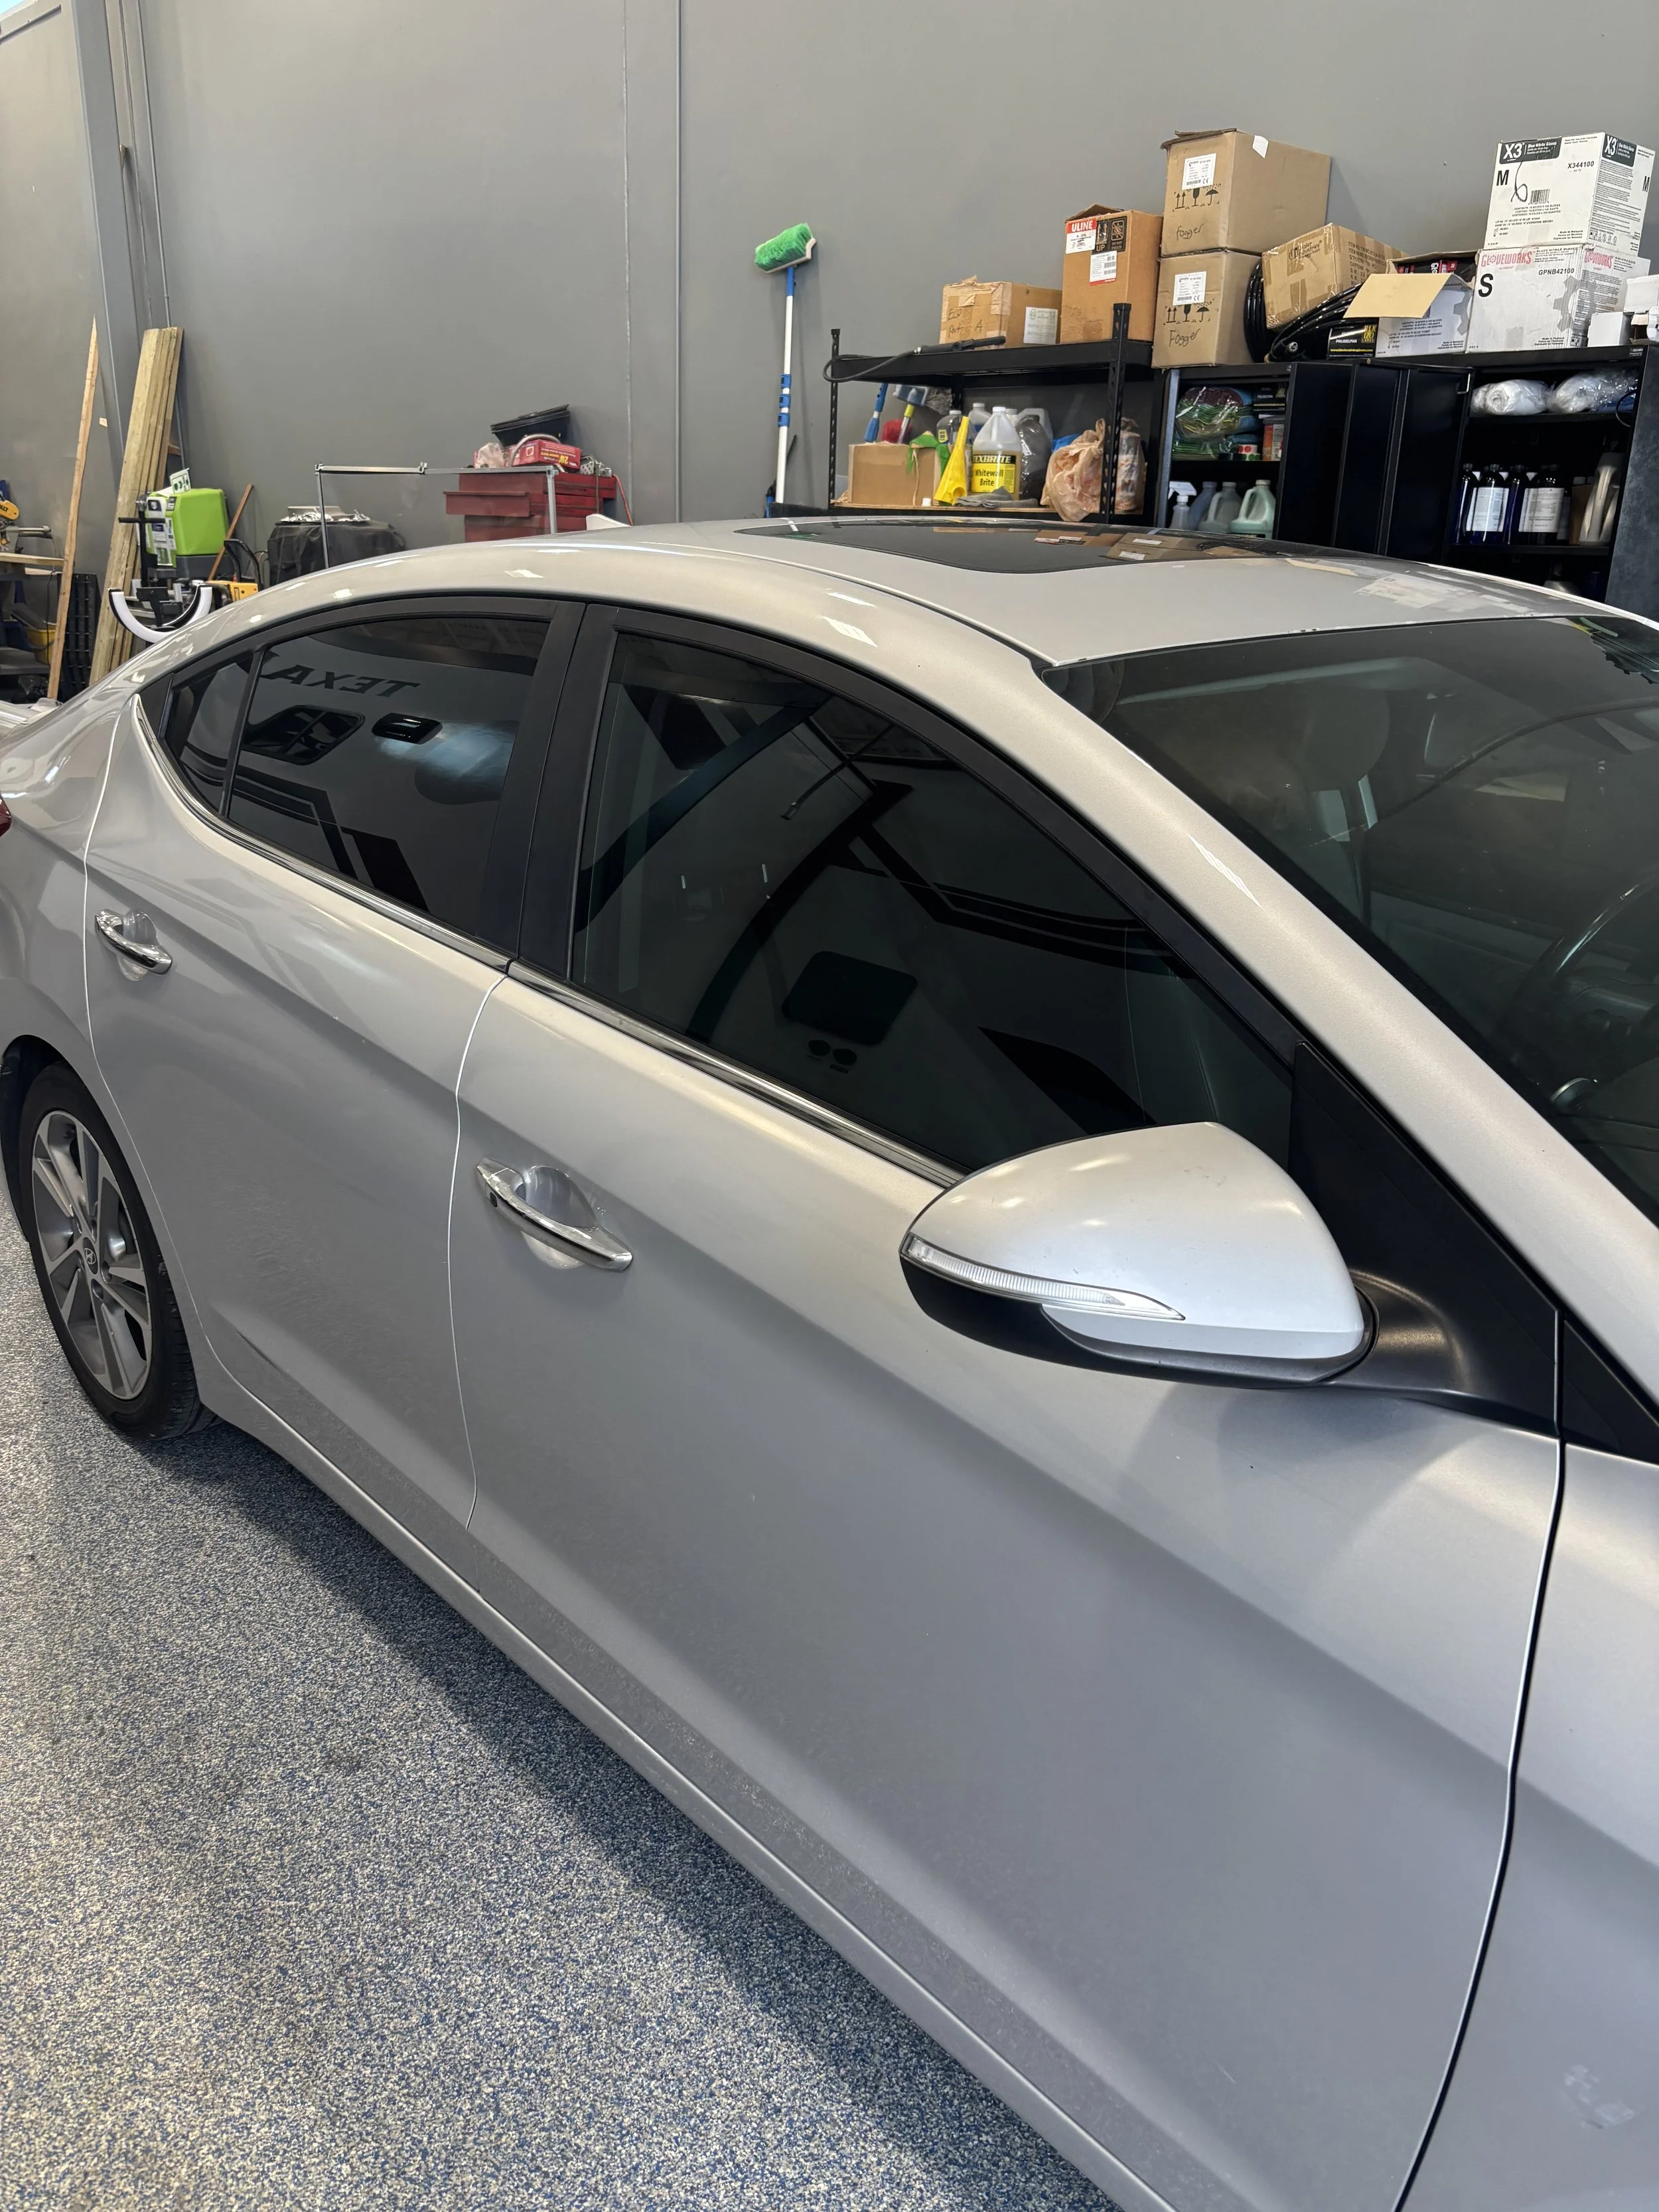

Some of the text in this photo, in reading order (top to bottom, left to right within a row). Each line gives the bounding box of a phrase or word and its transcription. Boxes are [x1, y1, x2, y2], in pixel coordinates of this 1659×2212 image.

[1503, 143, 1523, 159] X3
[1604, 135, 1617, 156] X3
[1567, 161, 1595, 169] X344100
[1496, 169, 1510, 186] M
[1642, 175, 1650, 192] M
[1072, 220, 1093, 232] ULINE
[1481, 251, 1532, 267] GLOVEWORKS
[1478, 273, 1494, 297] S
